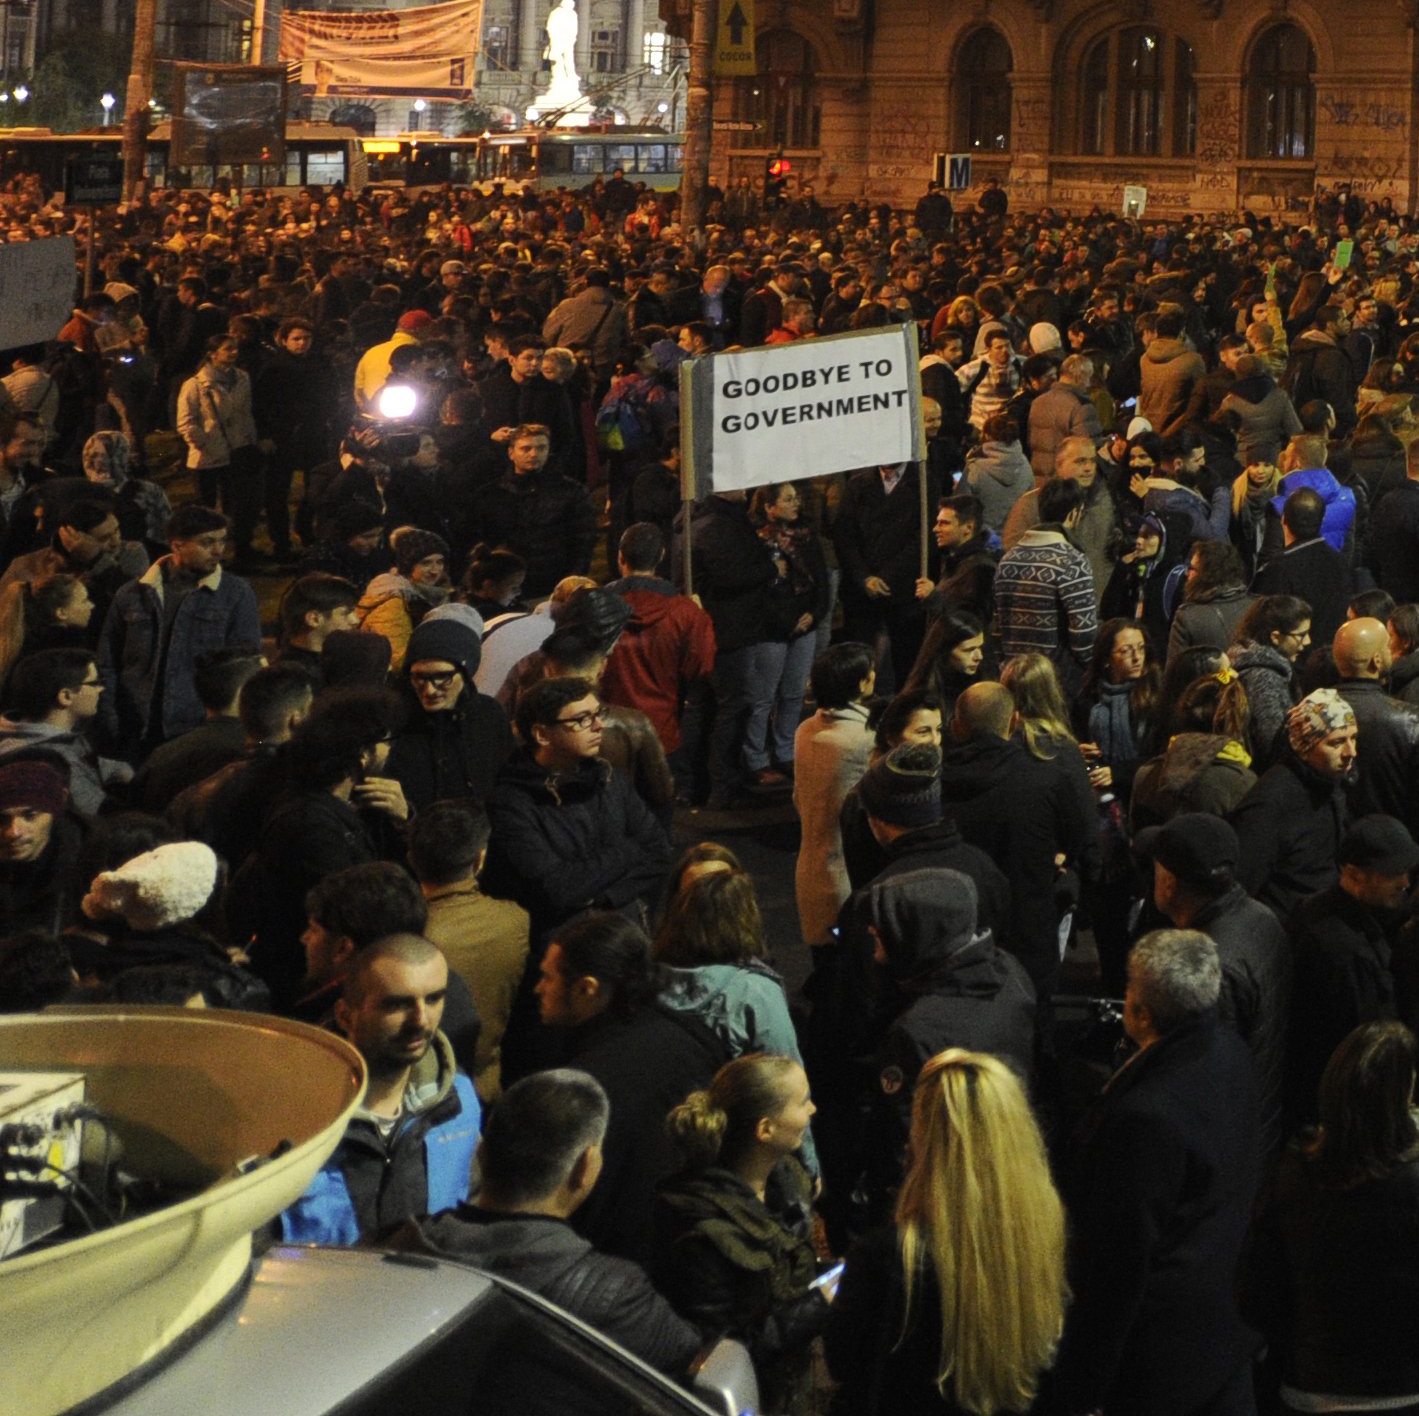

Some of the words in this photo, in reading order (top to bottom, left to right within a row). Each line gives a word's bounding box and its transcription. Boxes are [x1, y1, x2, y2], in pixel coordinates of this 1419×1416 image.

[721, 364, 851, 400] GOODBYE
[859, 359, 893, 380] TO
[721, 389, 908, 434] GOVERNMENT
